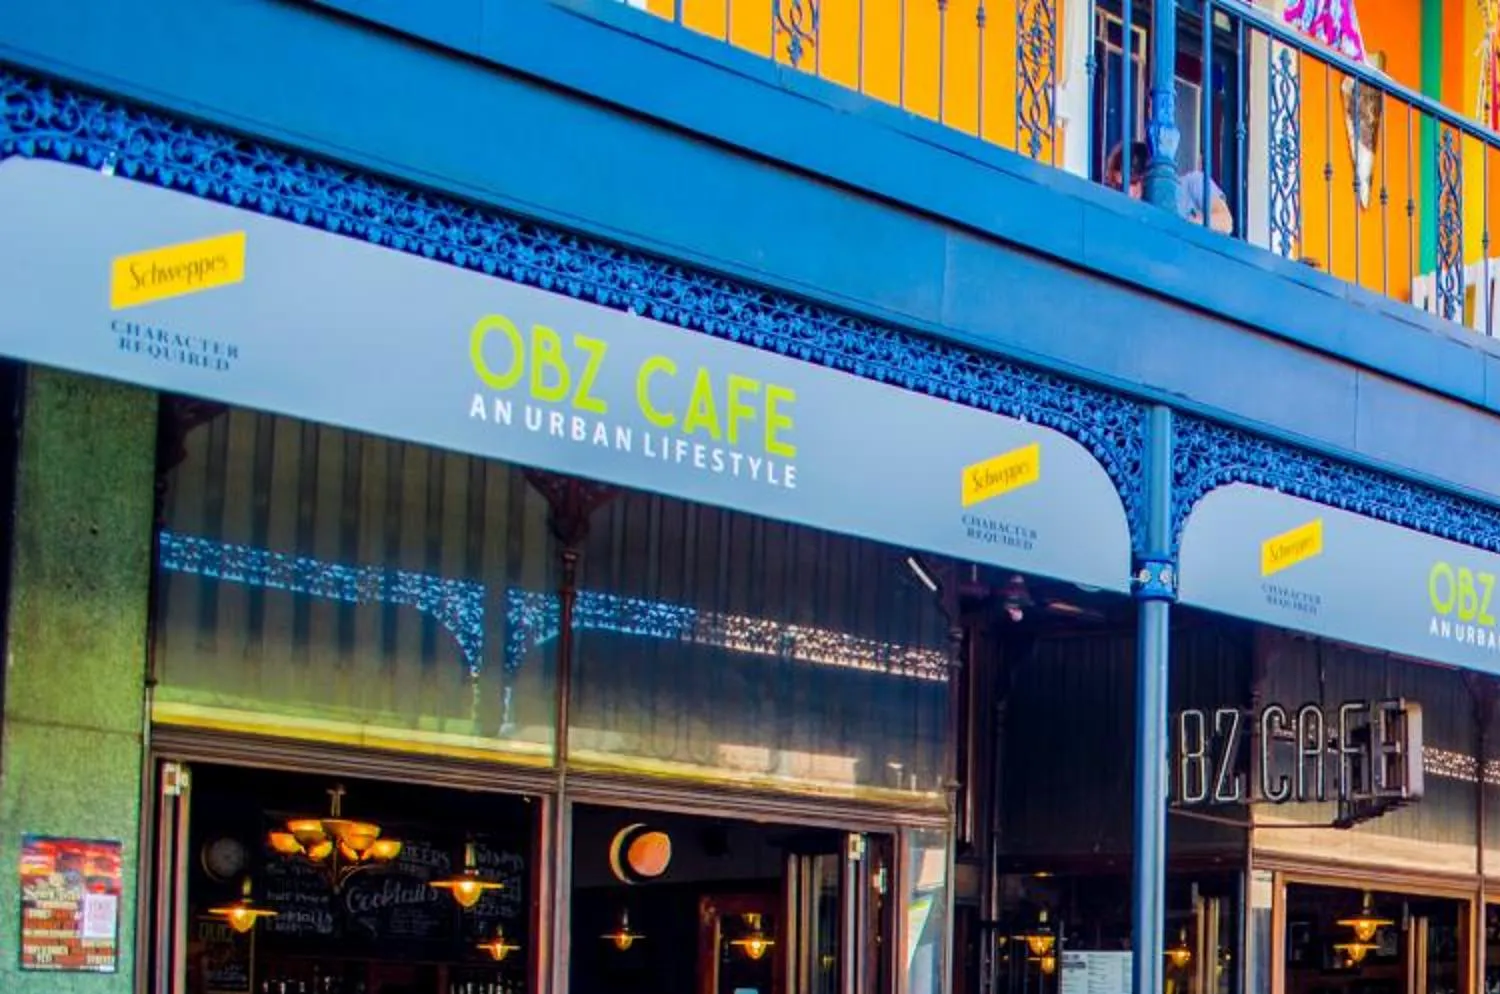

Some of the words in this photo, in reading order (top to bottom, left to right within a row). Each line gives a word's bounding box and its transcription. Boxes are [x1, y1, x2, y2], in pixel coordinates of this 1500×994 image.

[128, 253, 229, 291] Schweppes
[110, 319, 239, 359] CHARACTER
[118, 336, 230, 371] REQUIRED
[469, 313, 608, 414] OBZ
[636, 354, 797, 458] CAFE
[469, 393, 513, 426] AN
[524, 406, 632, 452] URBAN
[643, 432, 798, 489] LIFESTYLE
[1428, 561, 1497, 627] OBZ
[1429, 616, 1451, 639] AN
